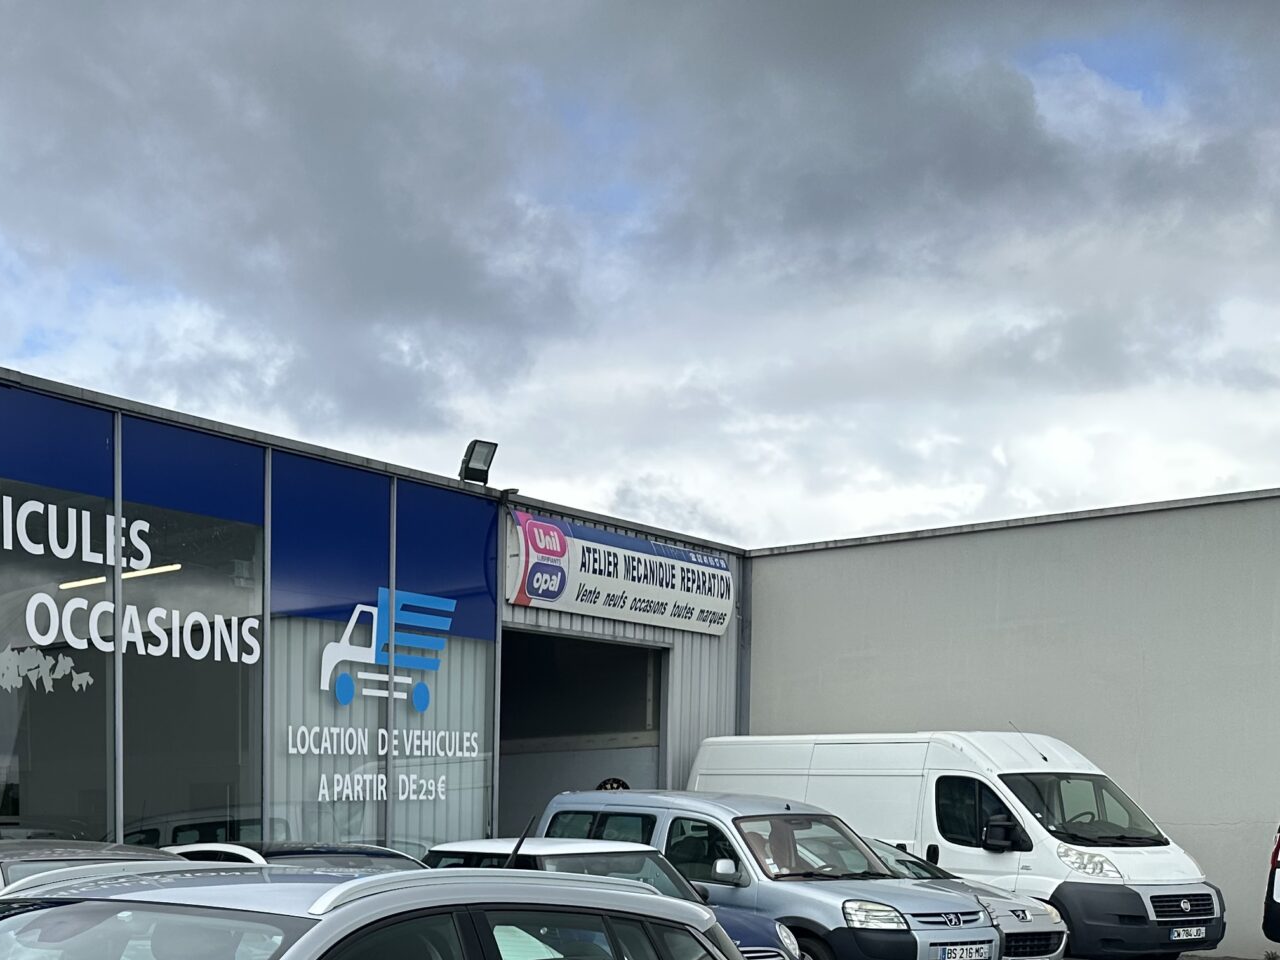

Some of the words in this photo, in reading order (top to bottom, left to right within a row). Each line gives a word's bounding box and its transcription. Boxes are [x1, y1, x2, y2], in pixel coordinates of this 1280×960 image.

[533, 527, 561, 552] Unil
[533, 572, 561, 594] opal
[580, 546, 618, 579] ATELIER
[623, 554, 675, 590] MECANIQUE
[680, 566, 731, 600] REPARATION
[575, 583, 600, 604] Vente
[603, 590, 628, 610] neufs
[630, 597, 668, 615] occasions
[670, 603, 694, 620] toutes
[696, 609, 727, 628] marques
[25, 592, 261, 664] OCCASIONS
[288, 725, 368, 755] LOCATION
[378, 728, 399, 757] DE
[403, 729, 479, 757] VEHICULES
[318, 774, 330, 801] A
[334, 774, 387, 801] PARTIR
